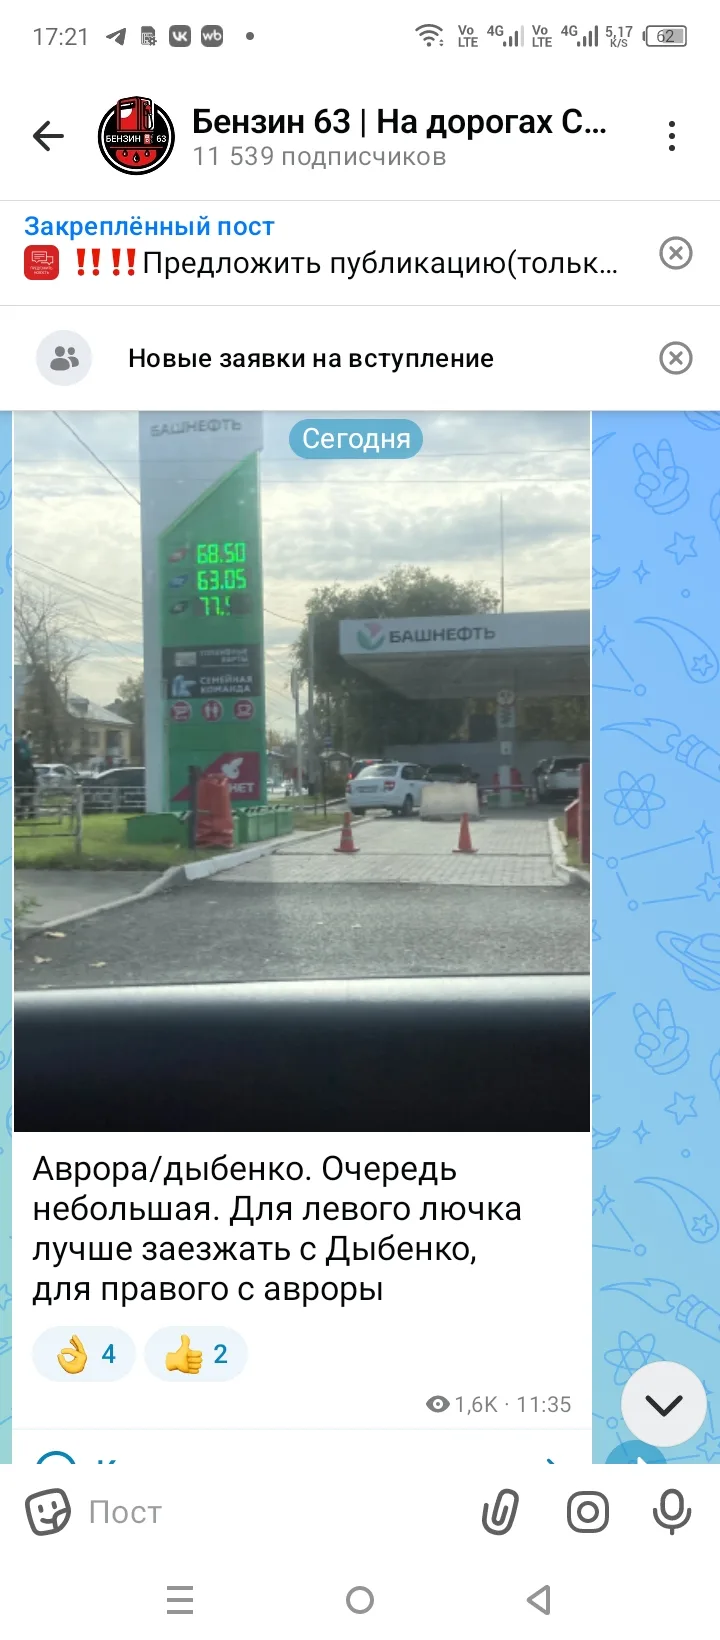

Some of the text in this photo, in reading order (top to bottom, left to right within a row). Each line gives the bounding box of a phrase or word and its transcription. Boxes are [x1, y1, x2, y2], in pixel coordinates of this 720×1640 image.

[33, 28, 88, 46] 17:21
[457, 24, 475, 36] Vo
[486, 25, 504, 37] 4G
[531, 24, 549, 36] Vo
[560, 25, 578, 37] 4G
[605, 25, 634, 39] 5,17
[656, 29, 676, 43] 62
[458, 37, 479, 48] LTE
[532, 37, 553, 48] LTE
[610, 38, 628, 49] K/S
[193, 107, 305, 134] Бензин
[314, 107, 351, 134] 63
[377, 108, 418, 135] На
[425, 113, 554, 141] дорогах
[105, 134, 168, 143] БЕНЗИН 63
[194, 146, 446, 170] 11 539 подписчиков
[24, 215, 276, 241] Закреплённый пост
[143, 250, 321, 280] Предложить
[129, 347, 494, 374] Новые заявки на вступление
[151, 418, 242, 437] БАШНЕФТЬ
[303, 427, 411, 453] Сегодня
[197, 542, 247, 564] 68.50
[197, 568, 247, 591] 63.05
[389, 626, 496, 644] БАШНЕФТЬ
[199, 674, 253, 685] СЕМЕЙНАЯ
[200, 685, 251, 694] КОМАНДА
[31, 1153, 457, 1188] Аврора/дыбенко. Очередь
[33, 1193, 522, 1227] небольшая. Для левого лючка
[32, 1233, 476, 1268] лучше заезжать с Дыбенко,
[32, 1281, 383, 1308] для правого с авроры
[101, 1343, 117, 1364] 4
[213, 1343, 228, 1364] 2
[455, 1395, 571, 1416] 1,6K 11:35
[90, 1499, 163, 1524] Пост
